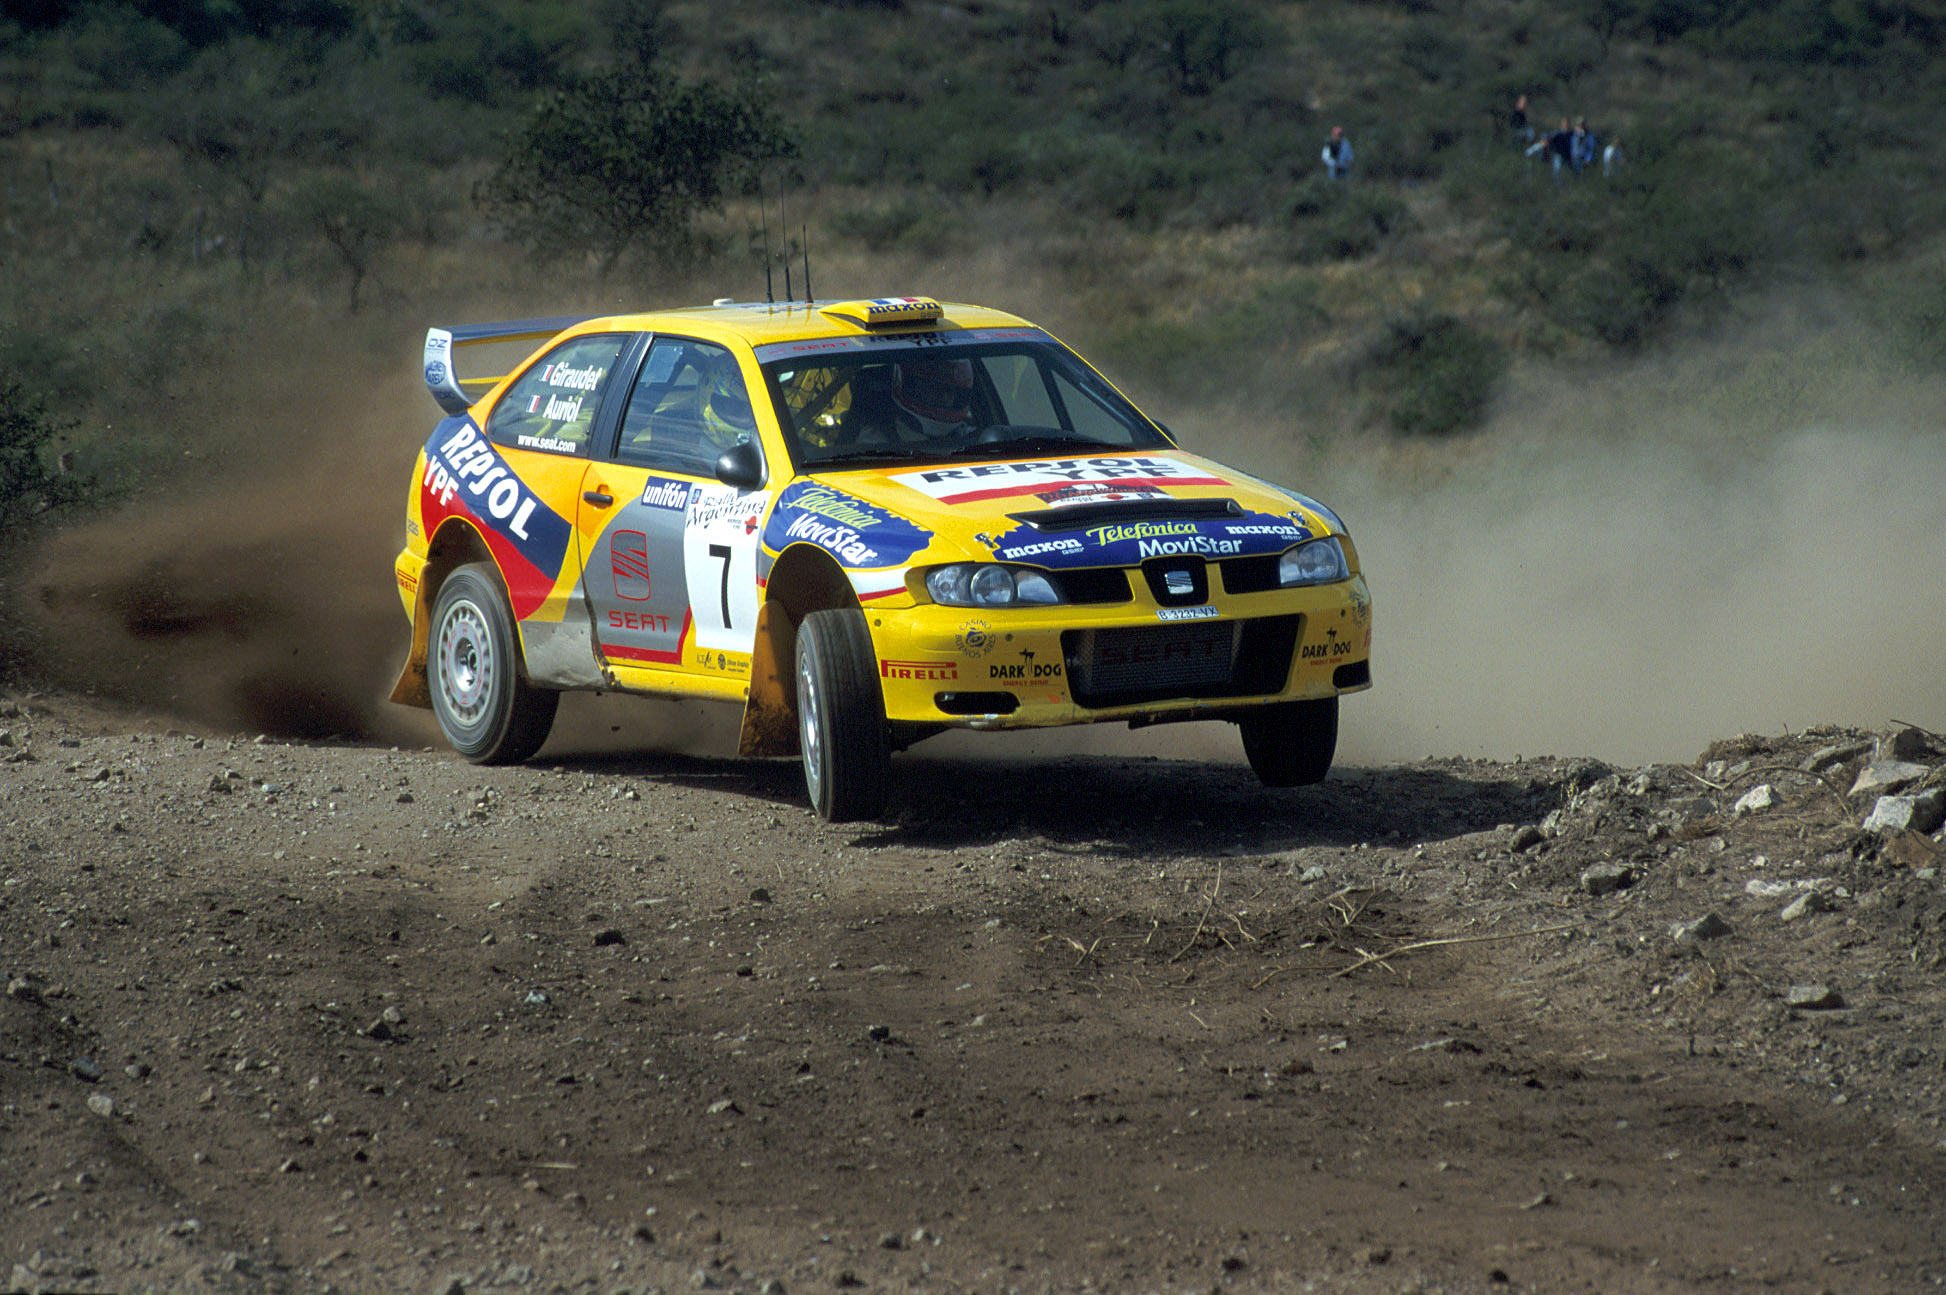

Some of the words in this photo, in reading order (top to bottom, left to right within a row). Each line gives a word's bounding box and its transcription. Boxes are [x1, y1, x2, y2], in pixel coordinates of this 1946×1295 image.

[866, 301, 941, 315] maxon
[791, 342, 849, 351] SEAT
[549, 361, 603, 391] Giraudet
[542, 393, 584, 422] Auriol
[517, 434, 577, 453] www.seat.com
[423, 455, 460, 507] YPF
[920, 458, 1169, 483] REPSOL
[1035, 466, 1178, 480] YPF
[440, 423, 537, 541] REPSOL
[642, 482, 688, 509] unifón
[785, 513, 878, 565] MoviStar
[1225, 525, 1300, 535] maxon
[1003, 538, 1082, 559] maxon
[1138, 536, 1242, 558] MoviStar
[709, 543, 732, 630] 7
[608, 610, 670, 633] SEAT
[959, 619, 992, 630] CASINO
[1301, 644, 1329, 659] DARK
[1333, 641, 1352, 656] DOG
[881, 659, 958, 680] PIRELLI
[990, 665, 1025, 678] DARK
[1034, 664, 1062, 677] DOG
